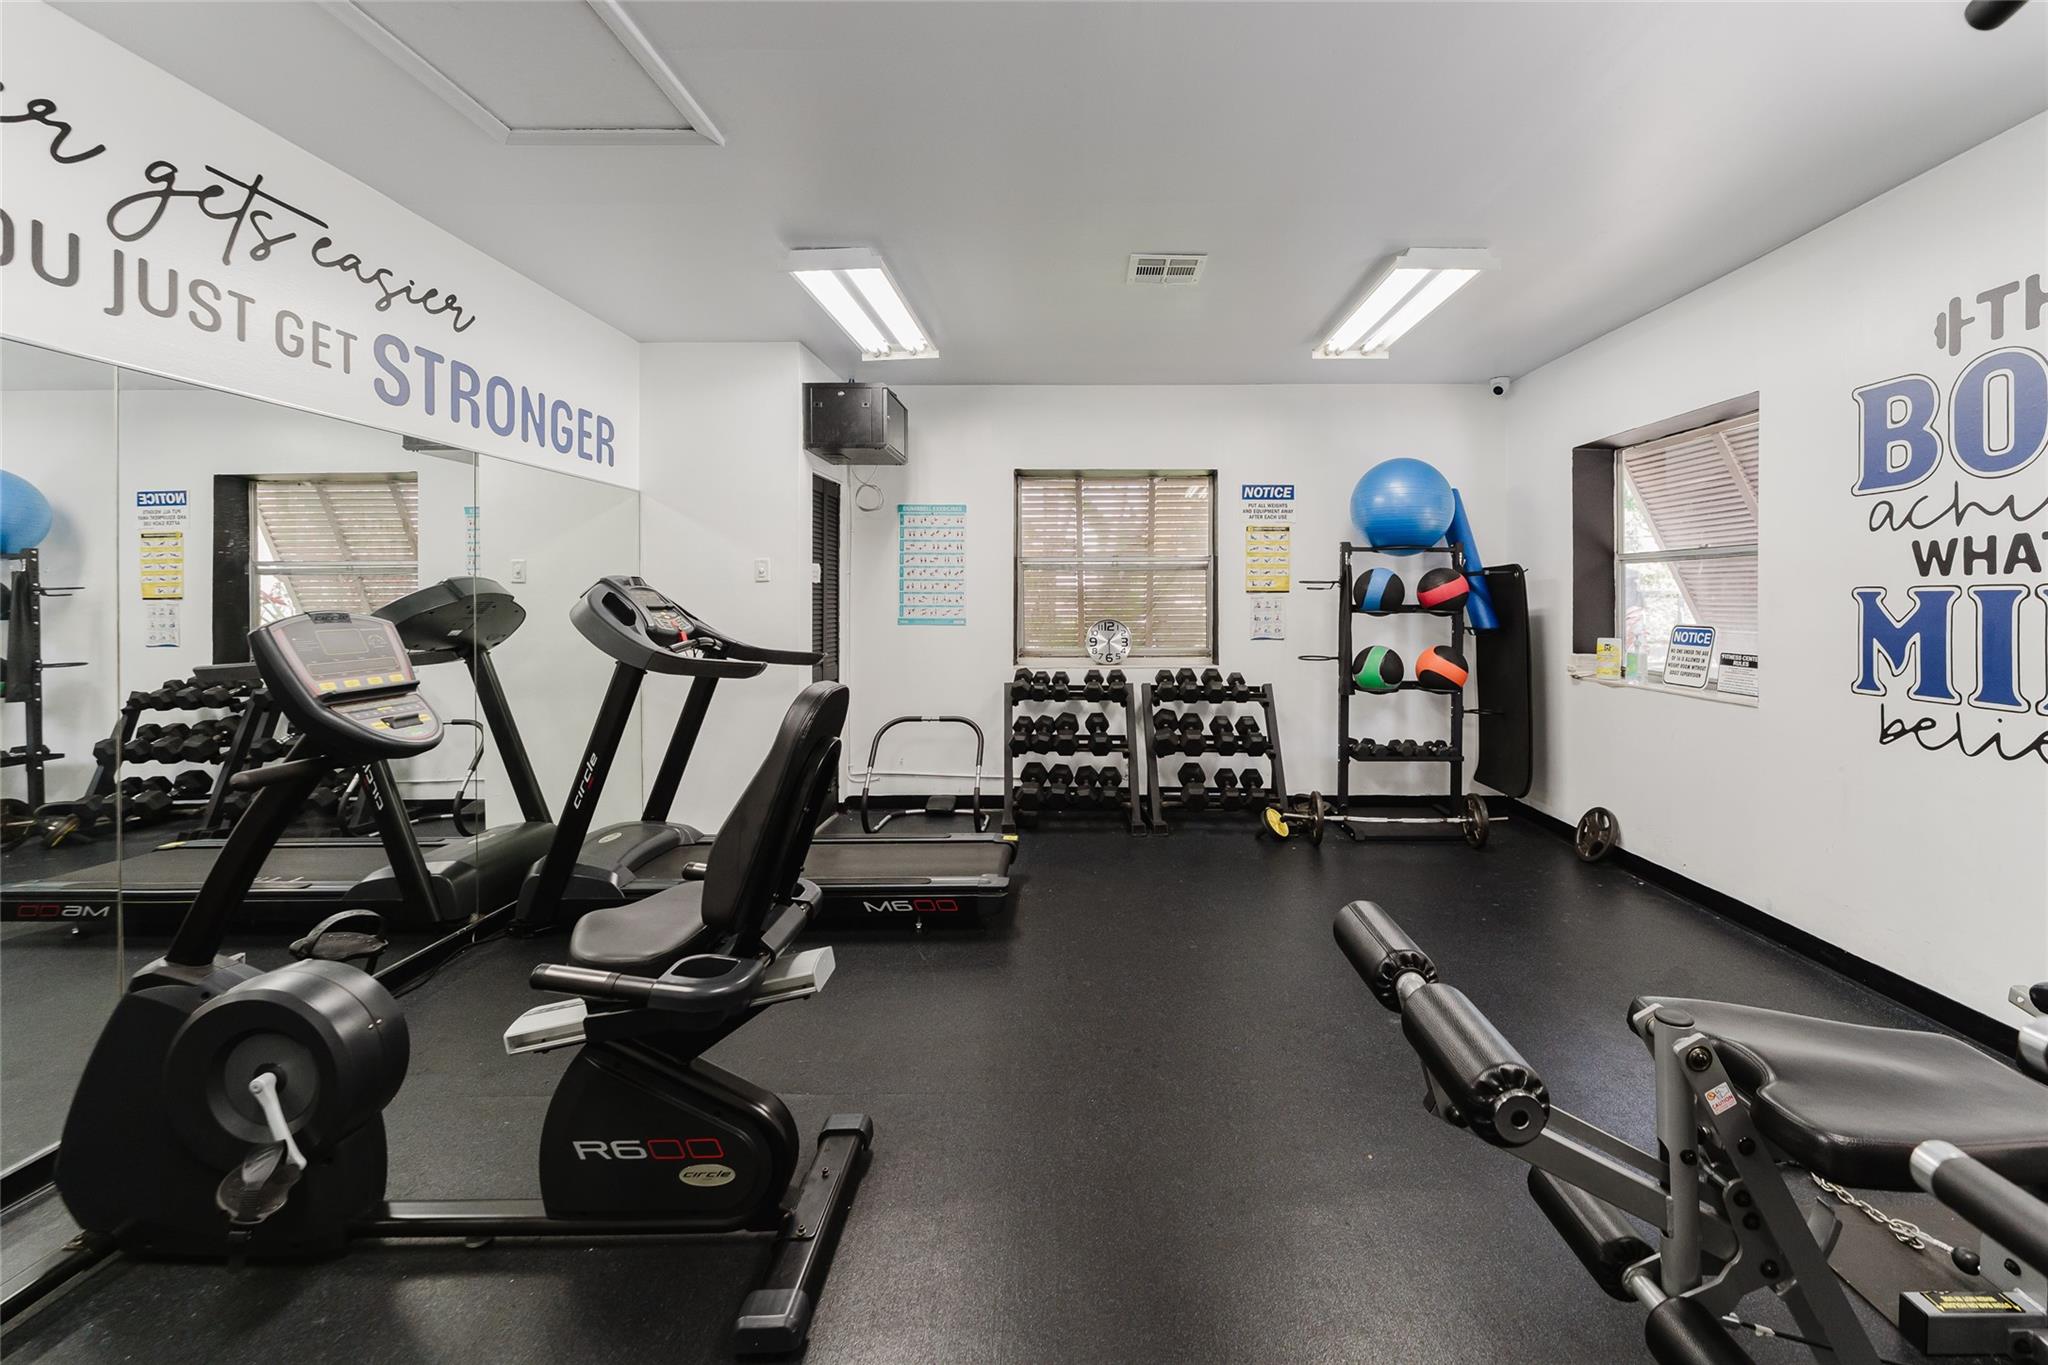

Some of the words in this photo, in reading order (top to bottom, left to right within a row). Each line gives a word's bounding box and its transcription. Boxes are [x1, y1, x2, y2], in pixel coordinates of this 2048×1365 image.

[0, 82, 106, 164] er
[106, 160, 329, 266] gets
[311, 236, 476, 333] easier
[104, 249, 256, 342] JUST
[275, 310, 358, 374] GET
[373, 333, 616, 468] STRONGER
[1244, 487, 1292, 498] NOTICE
[1911, 531, 2048, 577] WHA
[1104, 621, 1115, 631] 12
[1089, 637, 1097, 647] 9
[1121, 638, 1128, 647] 3
[1673, 631, 1711, 645] NOTICE
[1851, 583, 2048, 717] MI
[1106, 653, 1113, 662] 6
[573, 752, 598, 810] circle
[863, 899, 959, 912] M600
[572, 1138, 725, 1160] R600
[682, 1170, 731, 1179] circle
